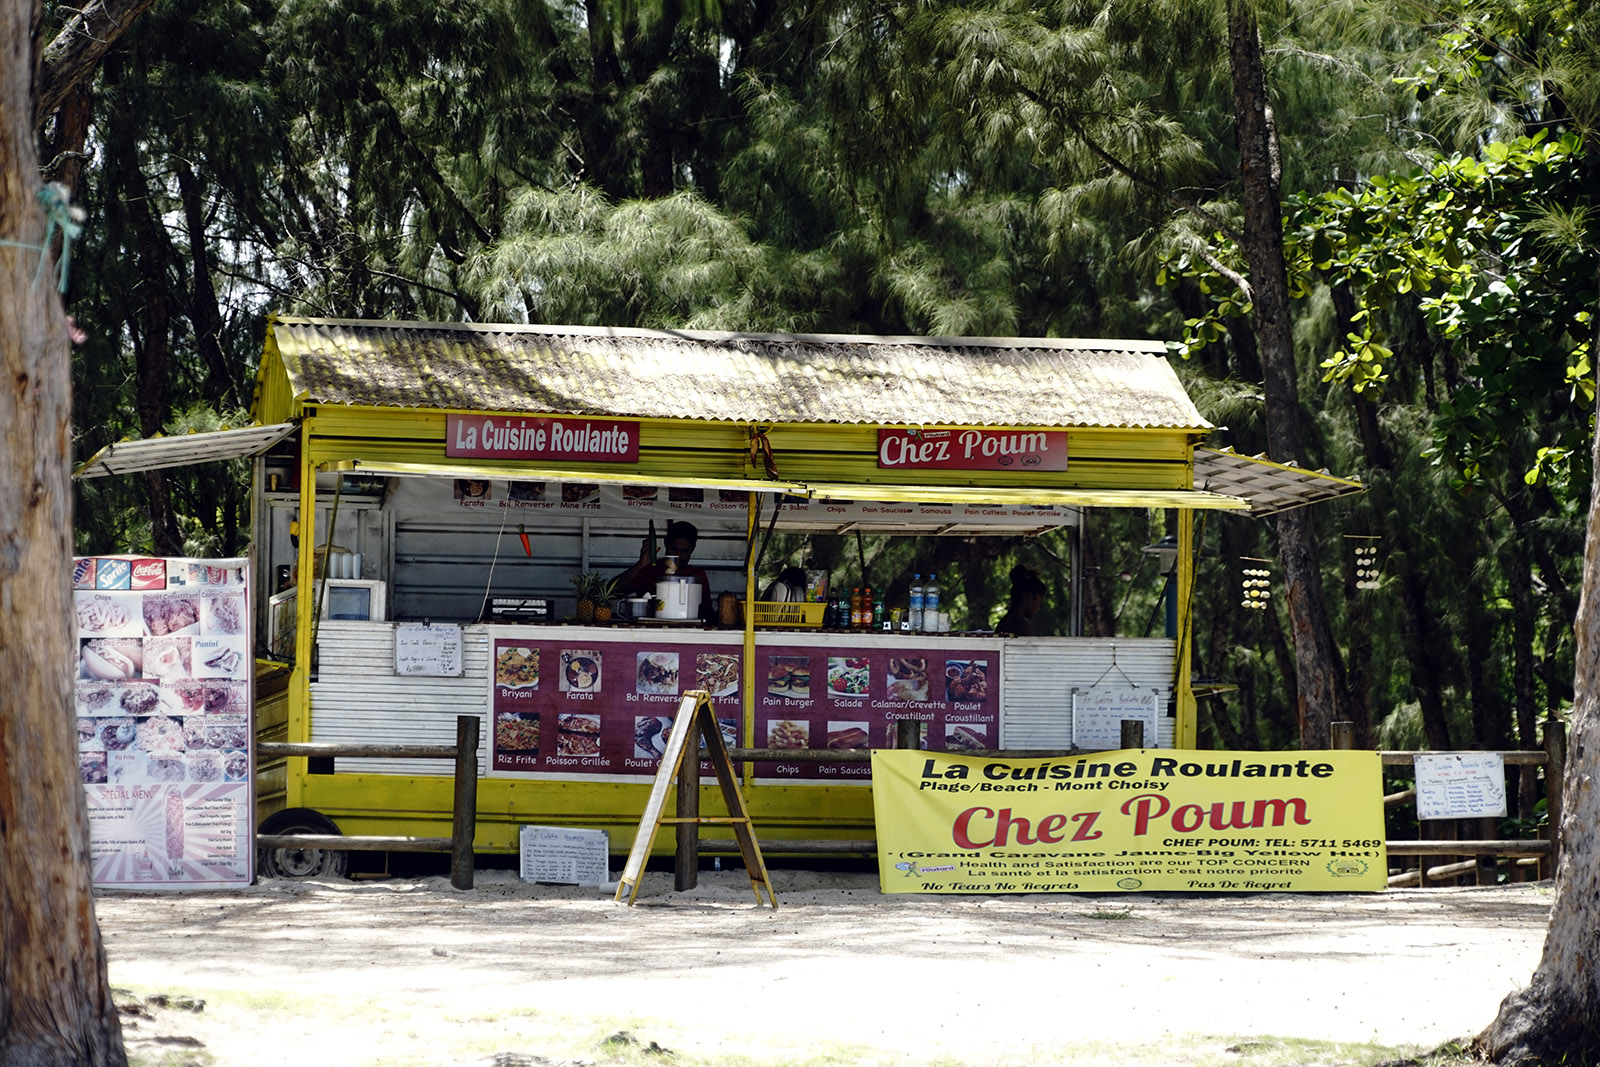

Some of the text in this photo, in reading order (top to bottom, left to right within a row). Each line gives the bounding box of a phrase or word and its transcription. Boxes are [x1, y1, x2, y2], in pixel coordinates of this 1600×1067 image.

[455, 419, 629, 454] La Cuisine Roulante
[880, 430, 1048, 466] Chez Poum
[582, 502, 601, 510] Frite
[827, 506, 846, 514] Chips
[73, 558, 92, 583] anta
[99, 562, 128, 587] Sprite
[194, 640, 219, 648] Panini
[502, 689, 533, 699] Briyani
[566, 691, 593, 701] Farata
[626, 693, 682, 703] Bol Renverse
[718, 696, 739, 704] Frite
[763, 697, 814, 708] Pain Burger
[834, 699, 863, 708] Salade
[871, 700, 946, 709] Calamar/Crevette
[954, 702, 981, 711] Poulet
[885, 711, 935, 721] Croustillant
[945, 714, 994, 723] Croustillant
[498, 755, 537, 765] Riz Frite
[546, 755, 610, 767] Poisson Grillée
[624, 758, 653, 768] Poulet
[776, 765, 799, 775] Chips
[819, 766, 871, 775] Pain Sauciss
[921, 757, 1334, 781] La Cuisine Roulante
[919, 781, 1038, 793] Plage/Beach
[1055, 781, 1103, 791] Mont
[1108, 780, 1169, 791] Choisy
[101, 790, 129, 800] SPECIAL
[952, 793, 1312, 850] Chez Poum
[1163, 838, 1381, 848] CHEF POUM: TEL: 5711 5469
[1073, 868, 1161, 876] satisfaction
[1250, 868, 1303, 876] priorité
[921, 882, 1079, 891] No Tears No Regrets
[1187, 880, 1292, 890] Pas De Regret
